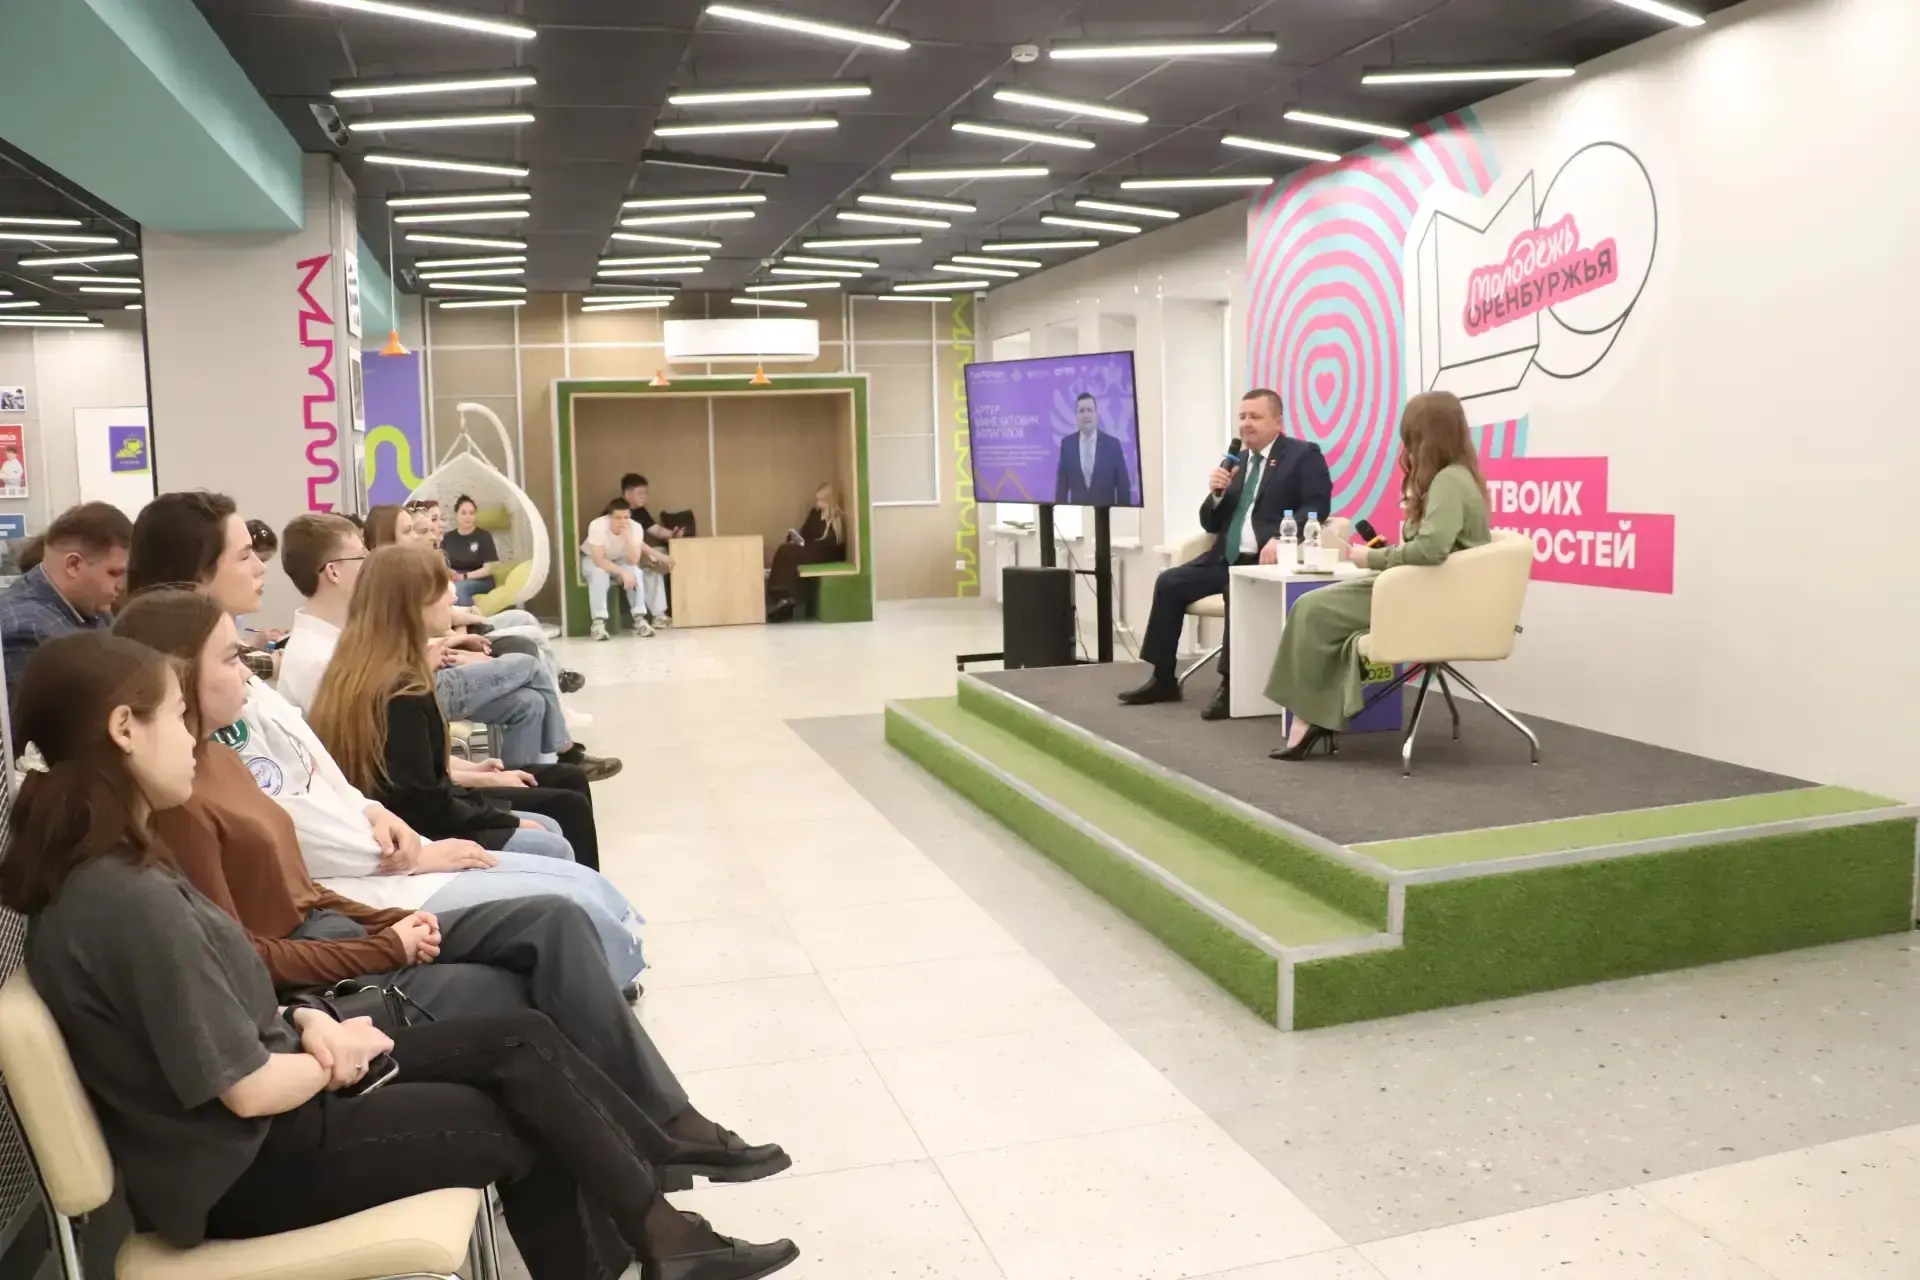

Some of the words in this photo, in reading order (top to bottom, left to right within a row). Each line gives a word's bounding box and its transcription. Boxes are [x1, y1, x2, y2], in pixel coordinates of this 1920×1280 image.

[1467, 248, 1613, 328] ОРЕНБУРЖЬЯ
[1486, 480, 1583, 516] ТВОИХ
[1513, 520, 1636, 569] ОСТЕЙ
[1367, 666, 1391, 681] 025
